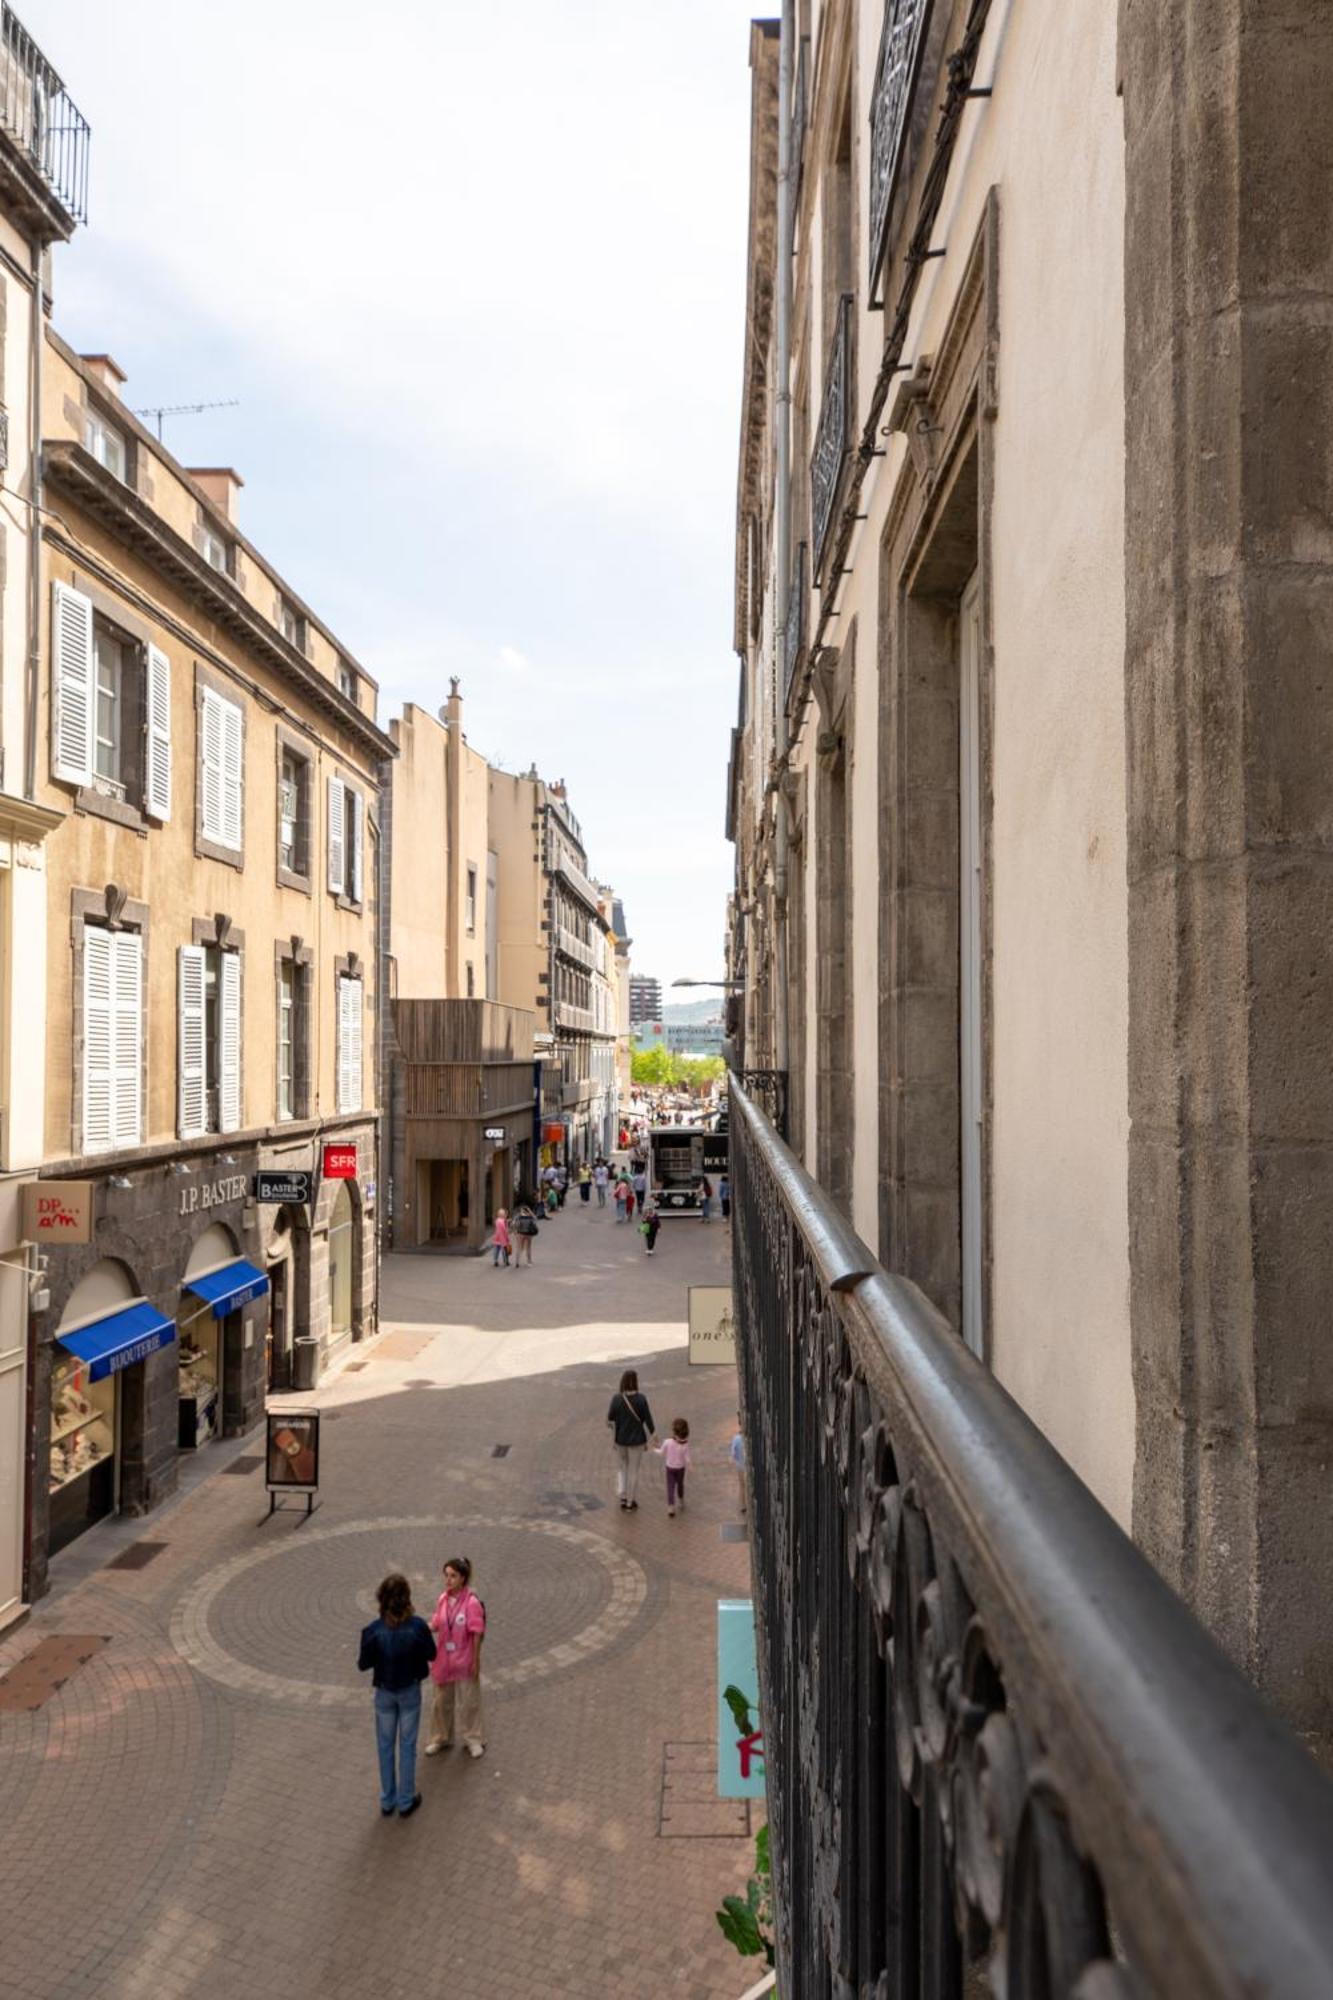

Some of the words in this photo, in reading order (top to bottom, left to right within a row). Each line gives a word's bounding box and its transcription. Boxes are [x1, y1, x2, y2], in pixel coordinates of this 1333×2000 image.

[330, 1155, 356, 1168] SFR
[179, 1188, 199, 1216] J.P.
[201, 1174, 247, 1209] BASTER
[261, 1183, 298, 1198] BASTER
[110, 1333, 161, 1373] BIJOUTERIE
